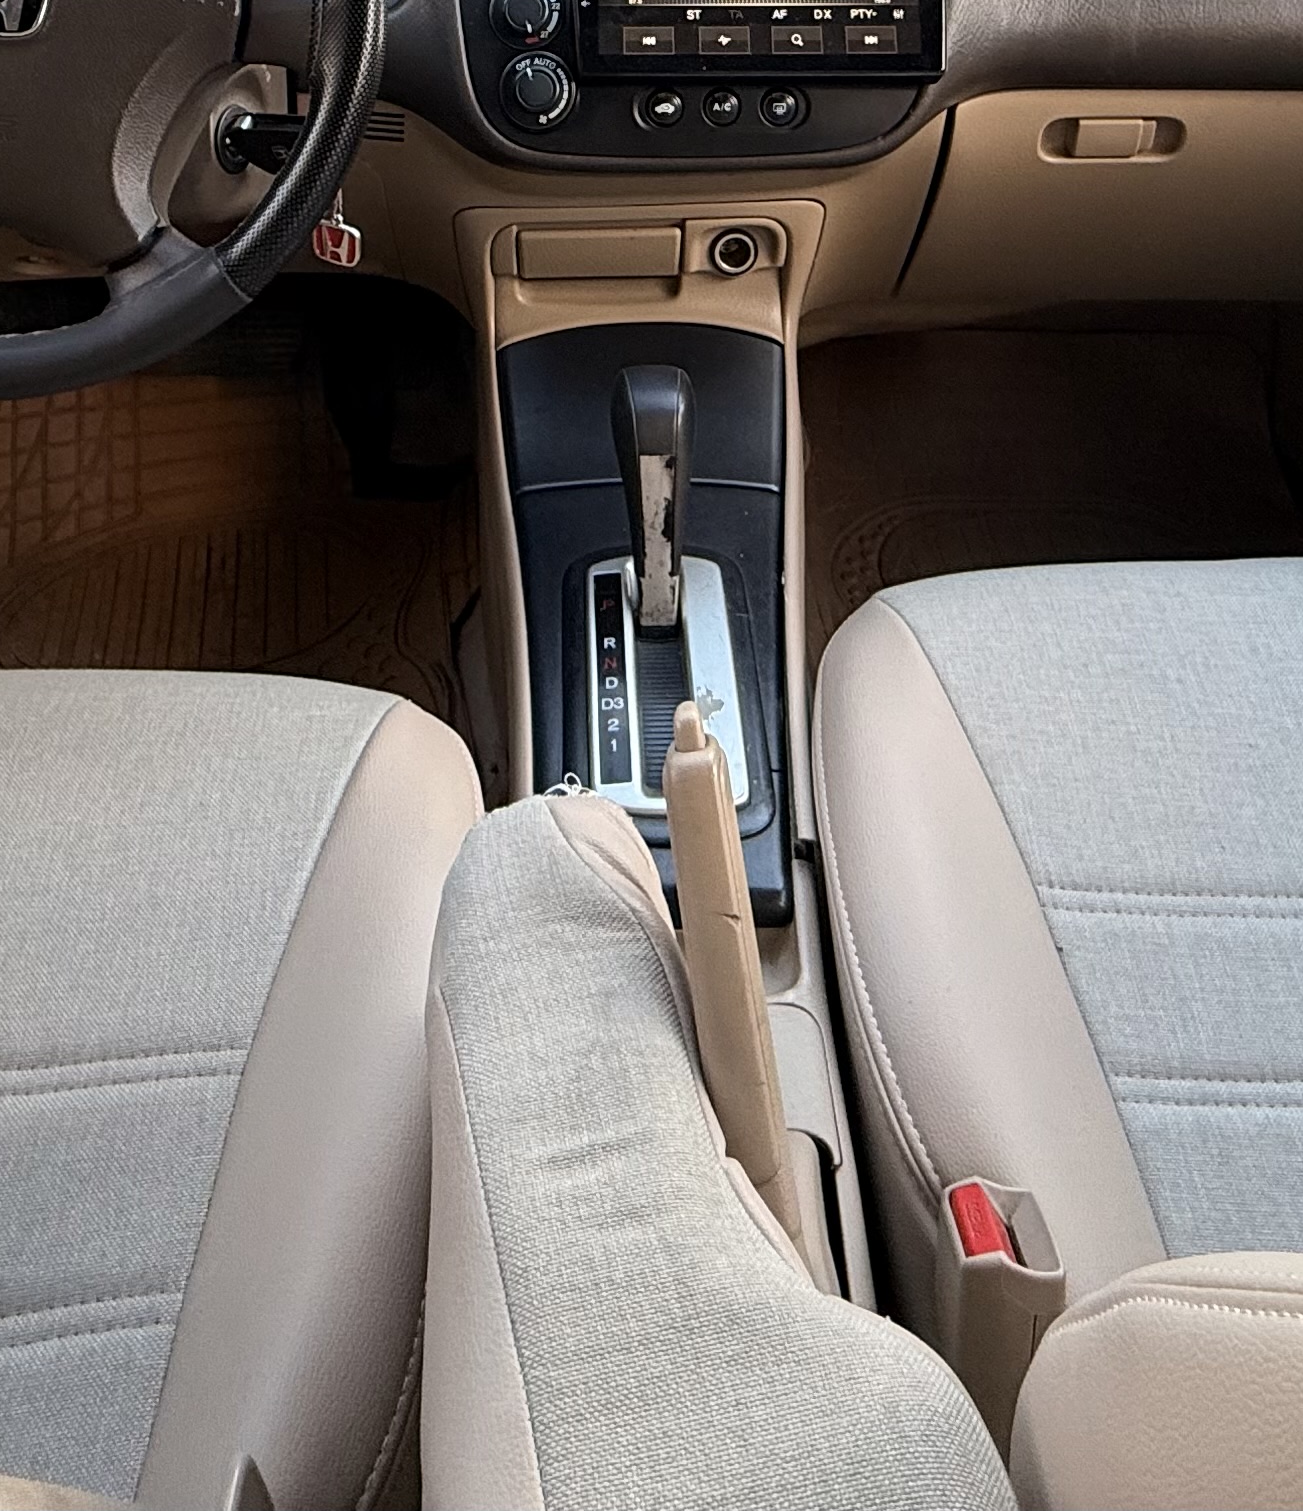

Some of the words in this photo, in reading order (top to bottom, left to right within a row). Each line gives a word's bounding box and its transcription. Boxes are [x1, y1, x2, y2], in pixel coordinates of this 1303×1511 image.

[686, 9, 702, 20] ST
[729, 10, 744, 19] TA
[771, 9, 788, 20] AF
[813, 9, 832, 19] DX
[515, 59, 532, 71] OFF
[533, 57, 556, 70] AUTO
[712, 102, 731, 112] A/C
[604, 637, 616, 649] R
[604, 657, 617, 669] N
[605, 677, 618, 689] D
[601, 697, 624, 710] D3
[607, 718, 619, 731] 2
[611, 739, 617, 752] 1
